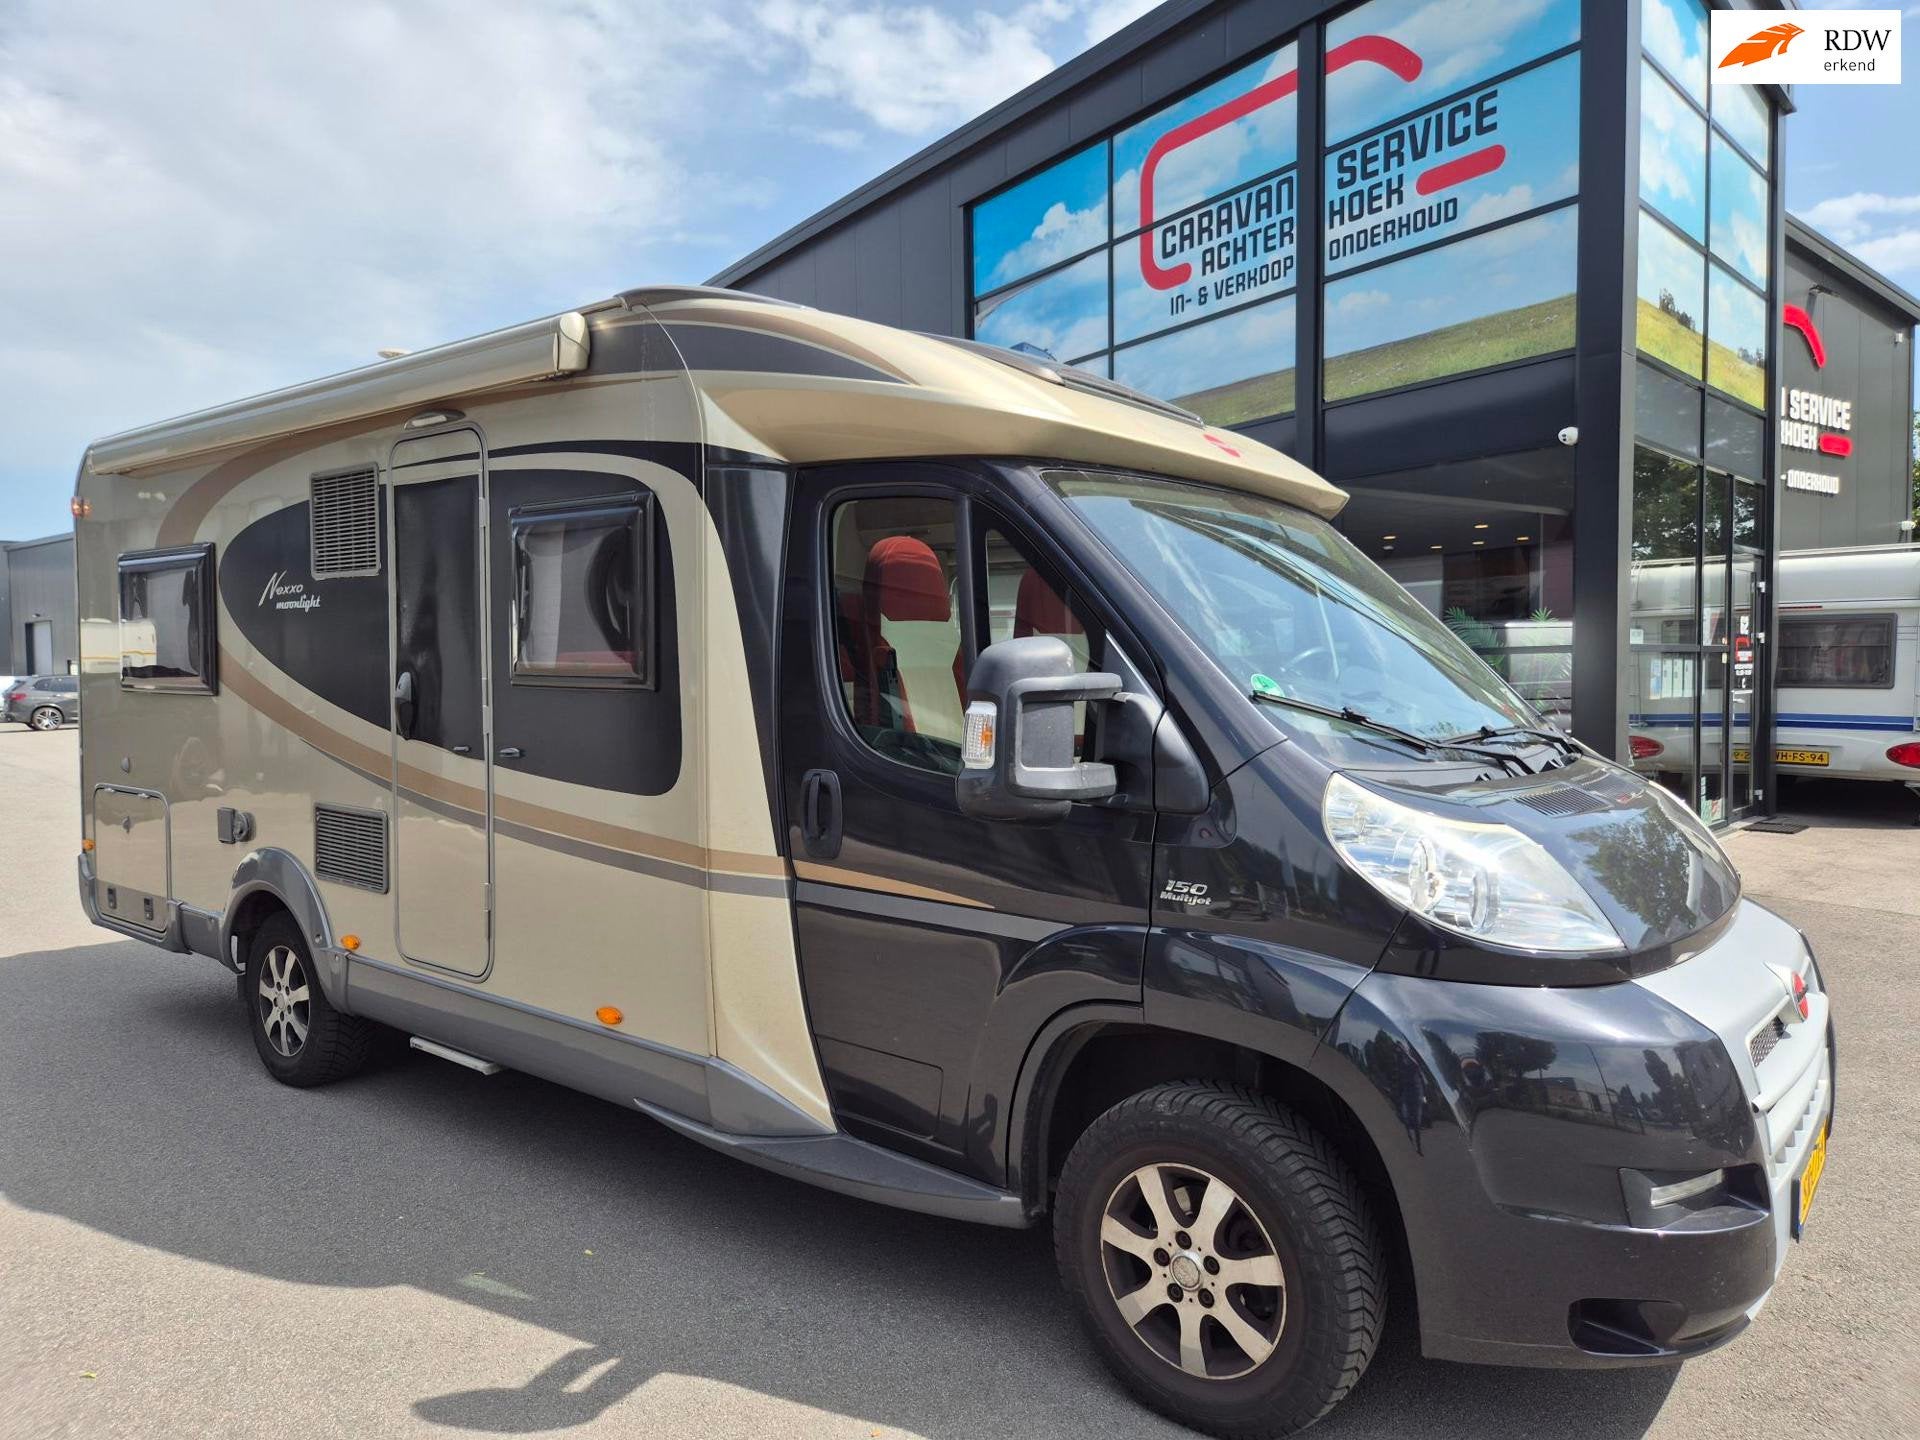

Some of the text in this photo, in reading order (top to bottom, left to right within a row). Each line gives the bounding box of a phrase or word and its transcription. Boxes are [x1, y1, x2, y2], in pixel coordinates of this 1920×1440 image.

[1161, 89, 1499, 260] CARAVAN SERVICE
[1201, 173, 1404, 276] ACHTER HOEK
[1170, 197, 1459, 316] IN- & VERKOOP ONDERHOUD
[1789, 389, 1851, 431] SERVICE
[258, 569, 304, 607] Nexxo
[275, 593, 321, 613] moonlight
[1160, 891, 1212, 906] Multijet
[1165, 879, 1208, 896] 150
